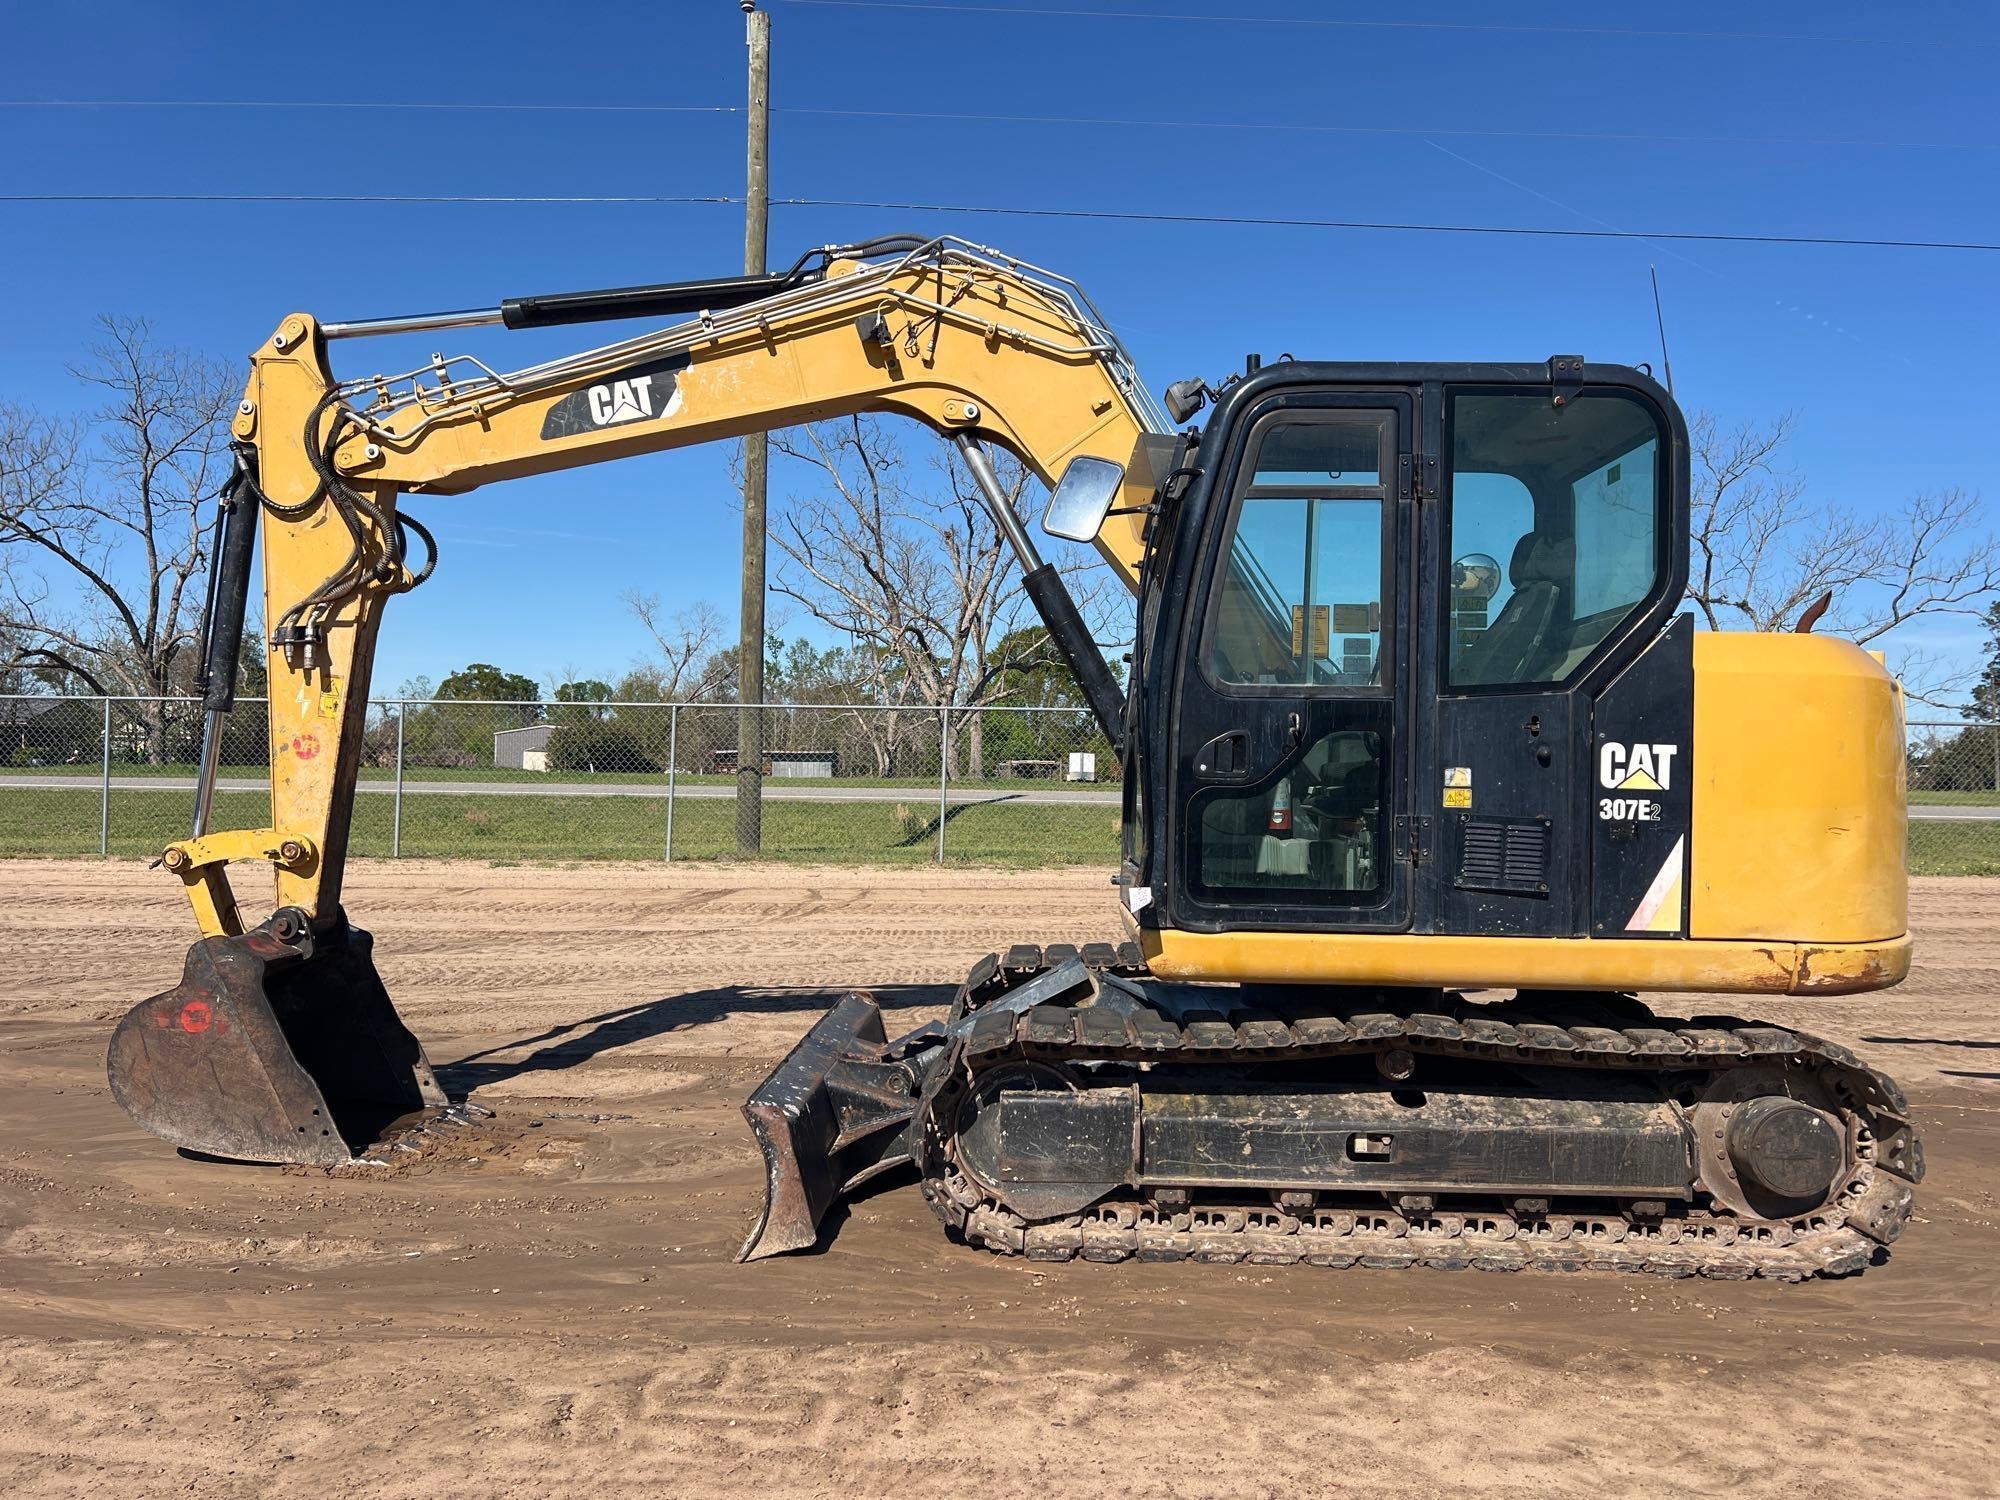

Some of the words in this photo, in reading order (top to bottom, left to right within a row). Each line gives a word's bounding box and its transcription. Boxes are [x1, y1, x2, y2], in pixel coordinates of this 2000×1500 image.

[588, 375, 653, 425] CAT
[1600, 742, 1678, 791] CAT
[1599, 798, 1662, 821] 307E2
